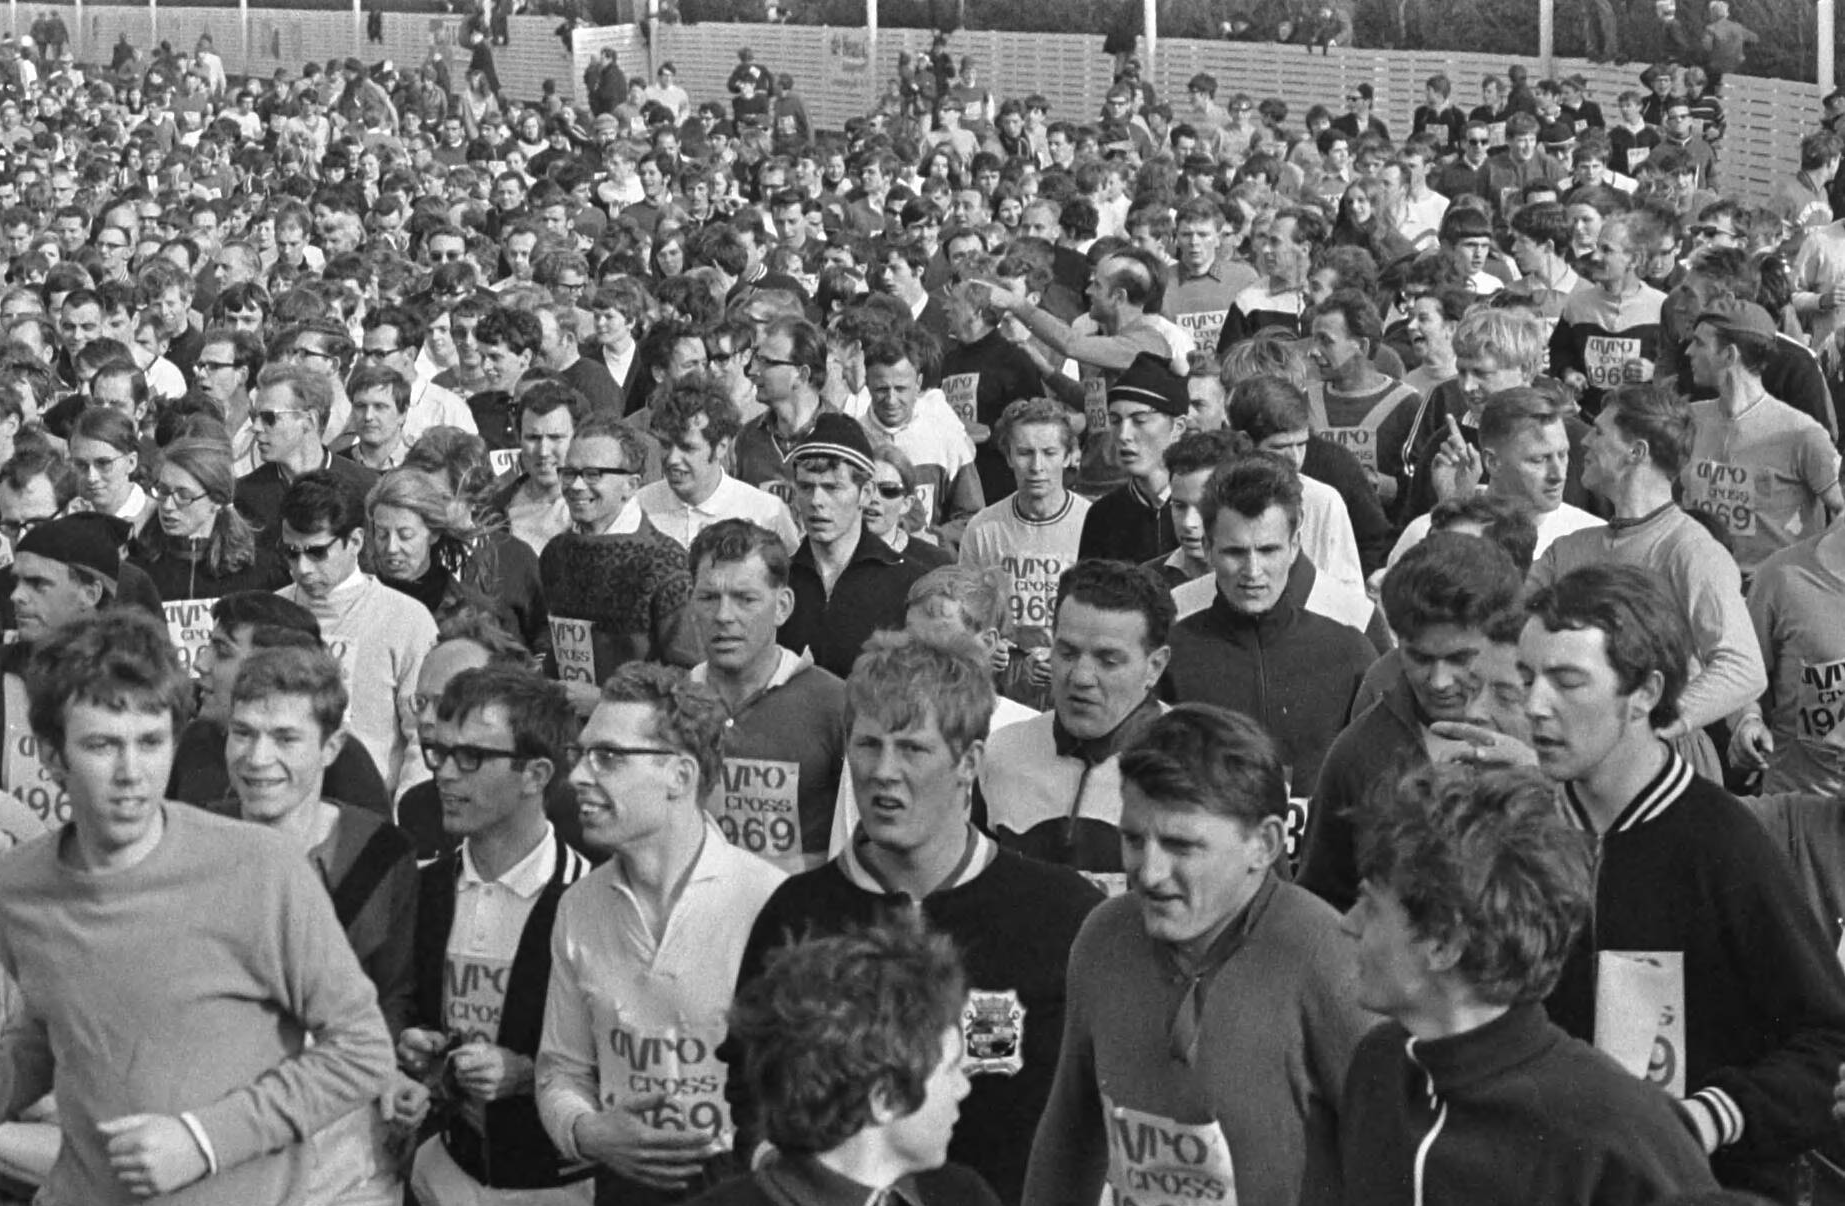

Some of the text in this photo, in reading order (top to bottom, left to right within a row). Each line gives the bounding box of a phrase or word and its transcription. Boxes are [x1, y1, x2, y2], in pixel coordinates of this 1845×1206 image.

[1588, 366, 1621, 385] 196
[1697, 462, 1747, 485] avro
[1002, 557, 1060, 579] avro
[1009, 595, 1057, 621] 969
[722, 765, 786, 793] vro
[725, 795, 792, 812] cross
[717, 815, 795, 852] 969
[611, 1029, 707, 1072] avro
[629, 1075, 719, 1096] cross
[1128, 1166, 1226, 1200] cross
